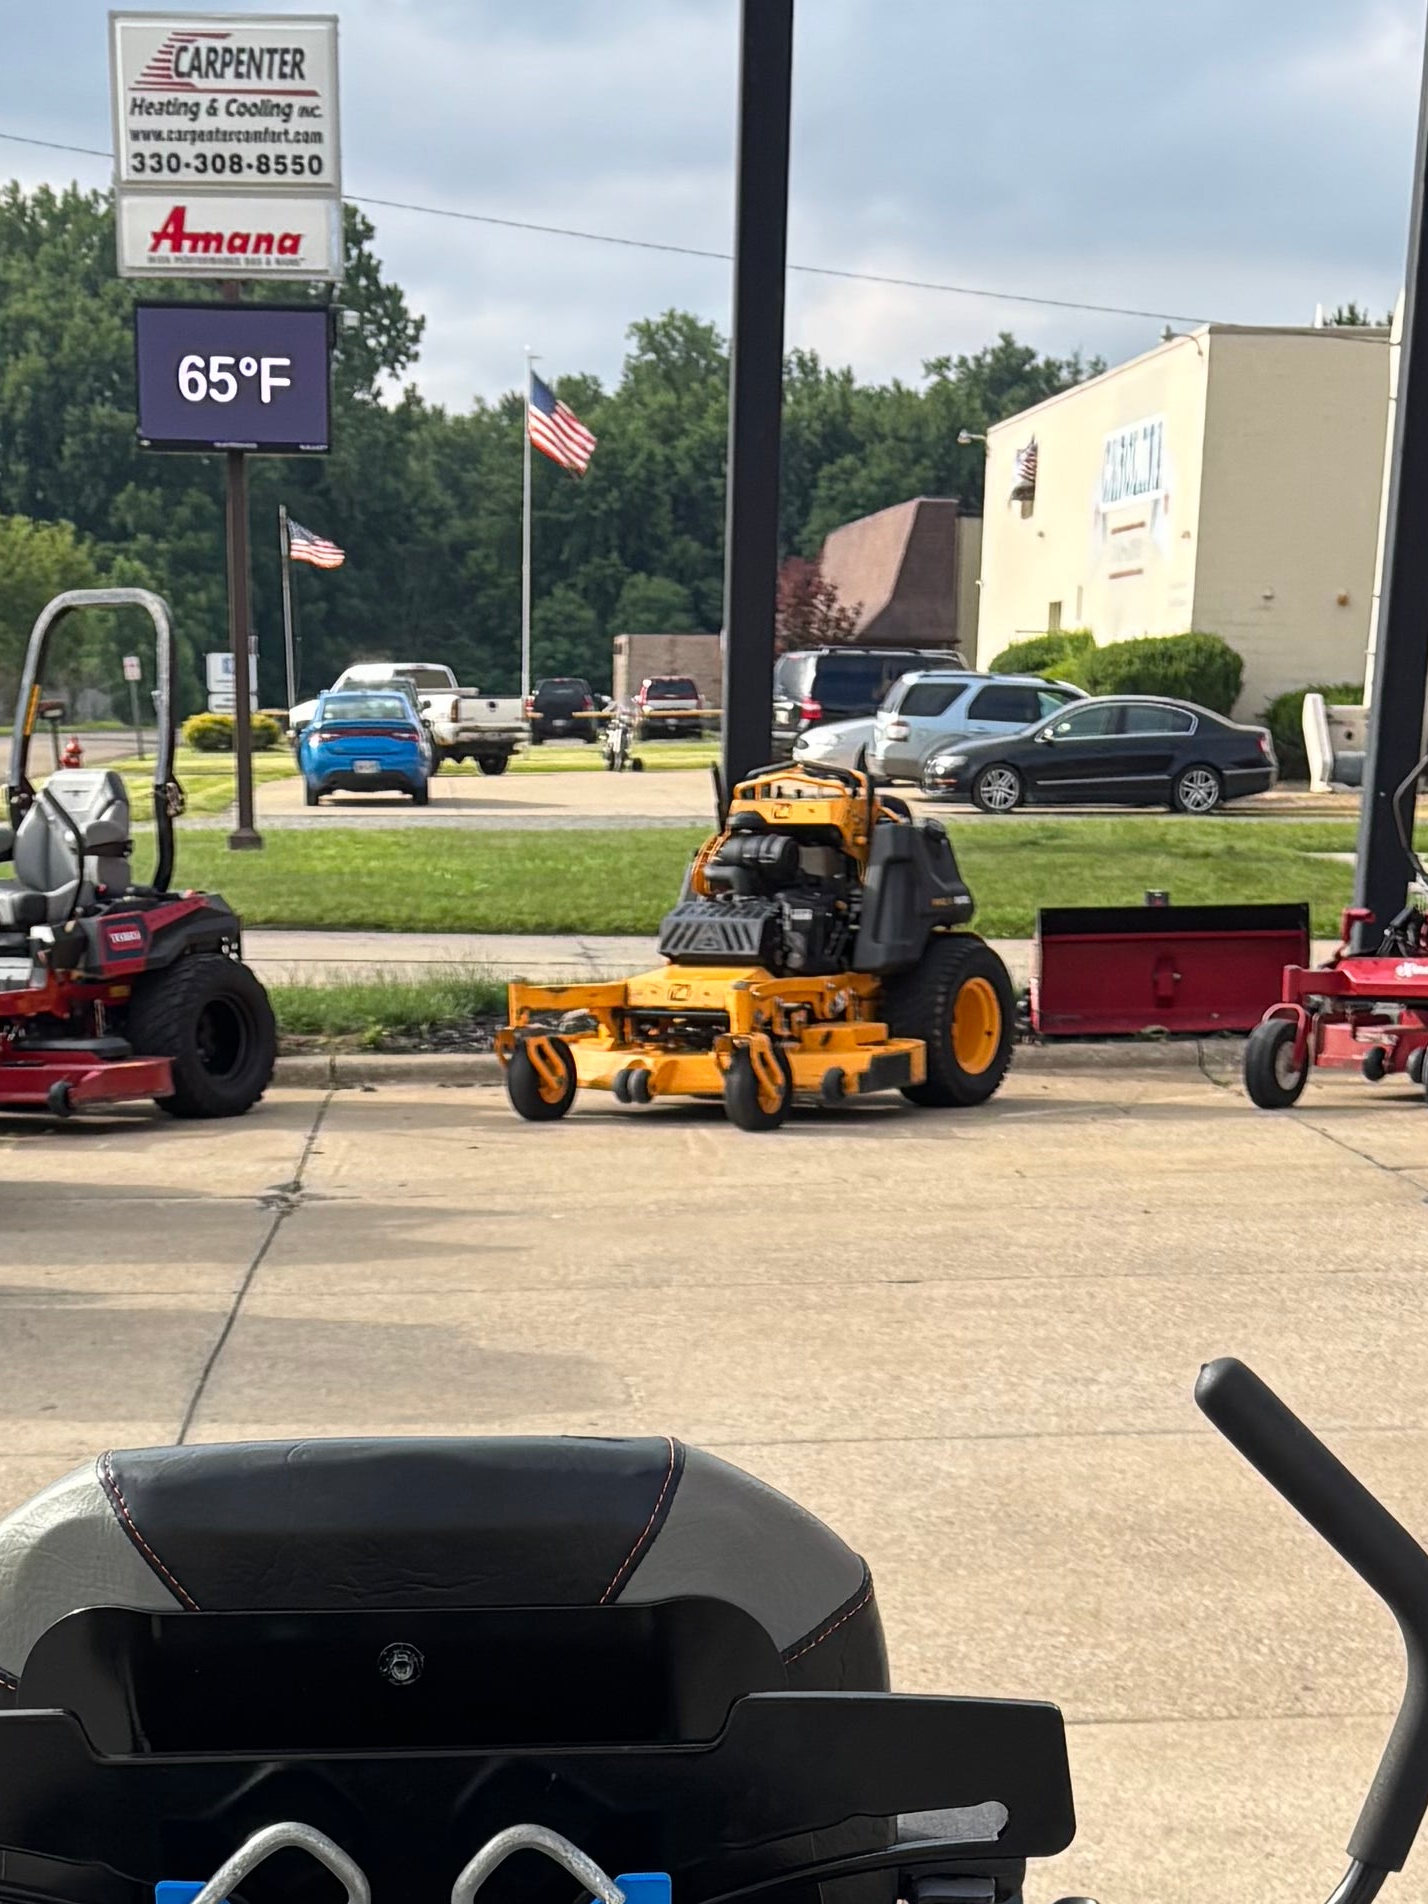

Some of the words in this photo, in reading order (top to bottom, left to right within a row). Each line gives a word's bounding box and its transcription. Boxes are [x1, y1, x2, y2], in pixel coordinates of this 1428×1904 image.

[174, 46, 305, 80] CARPENTER
[129, 97, 200, 121] Heating
[206, 99, 219, 116] &
[225, 98, 294, 122] Cooling
[148, 205, 302, 255] Amana
[178, 355, 291, 403] 65°F
